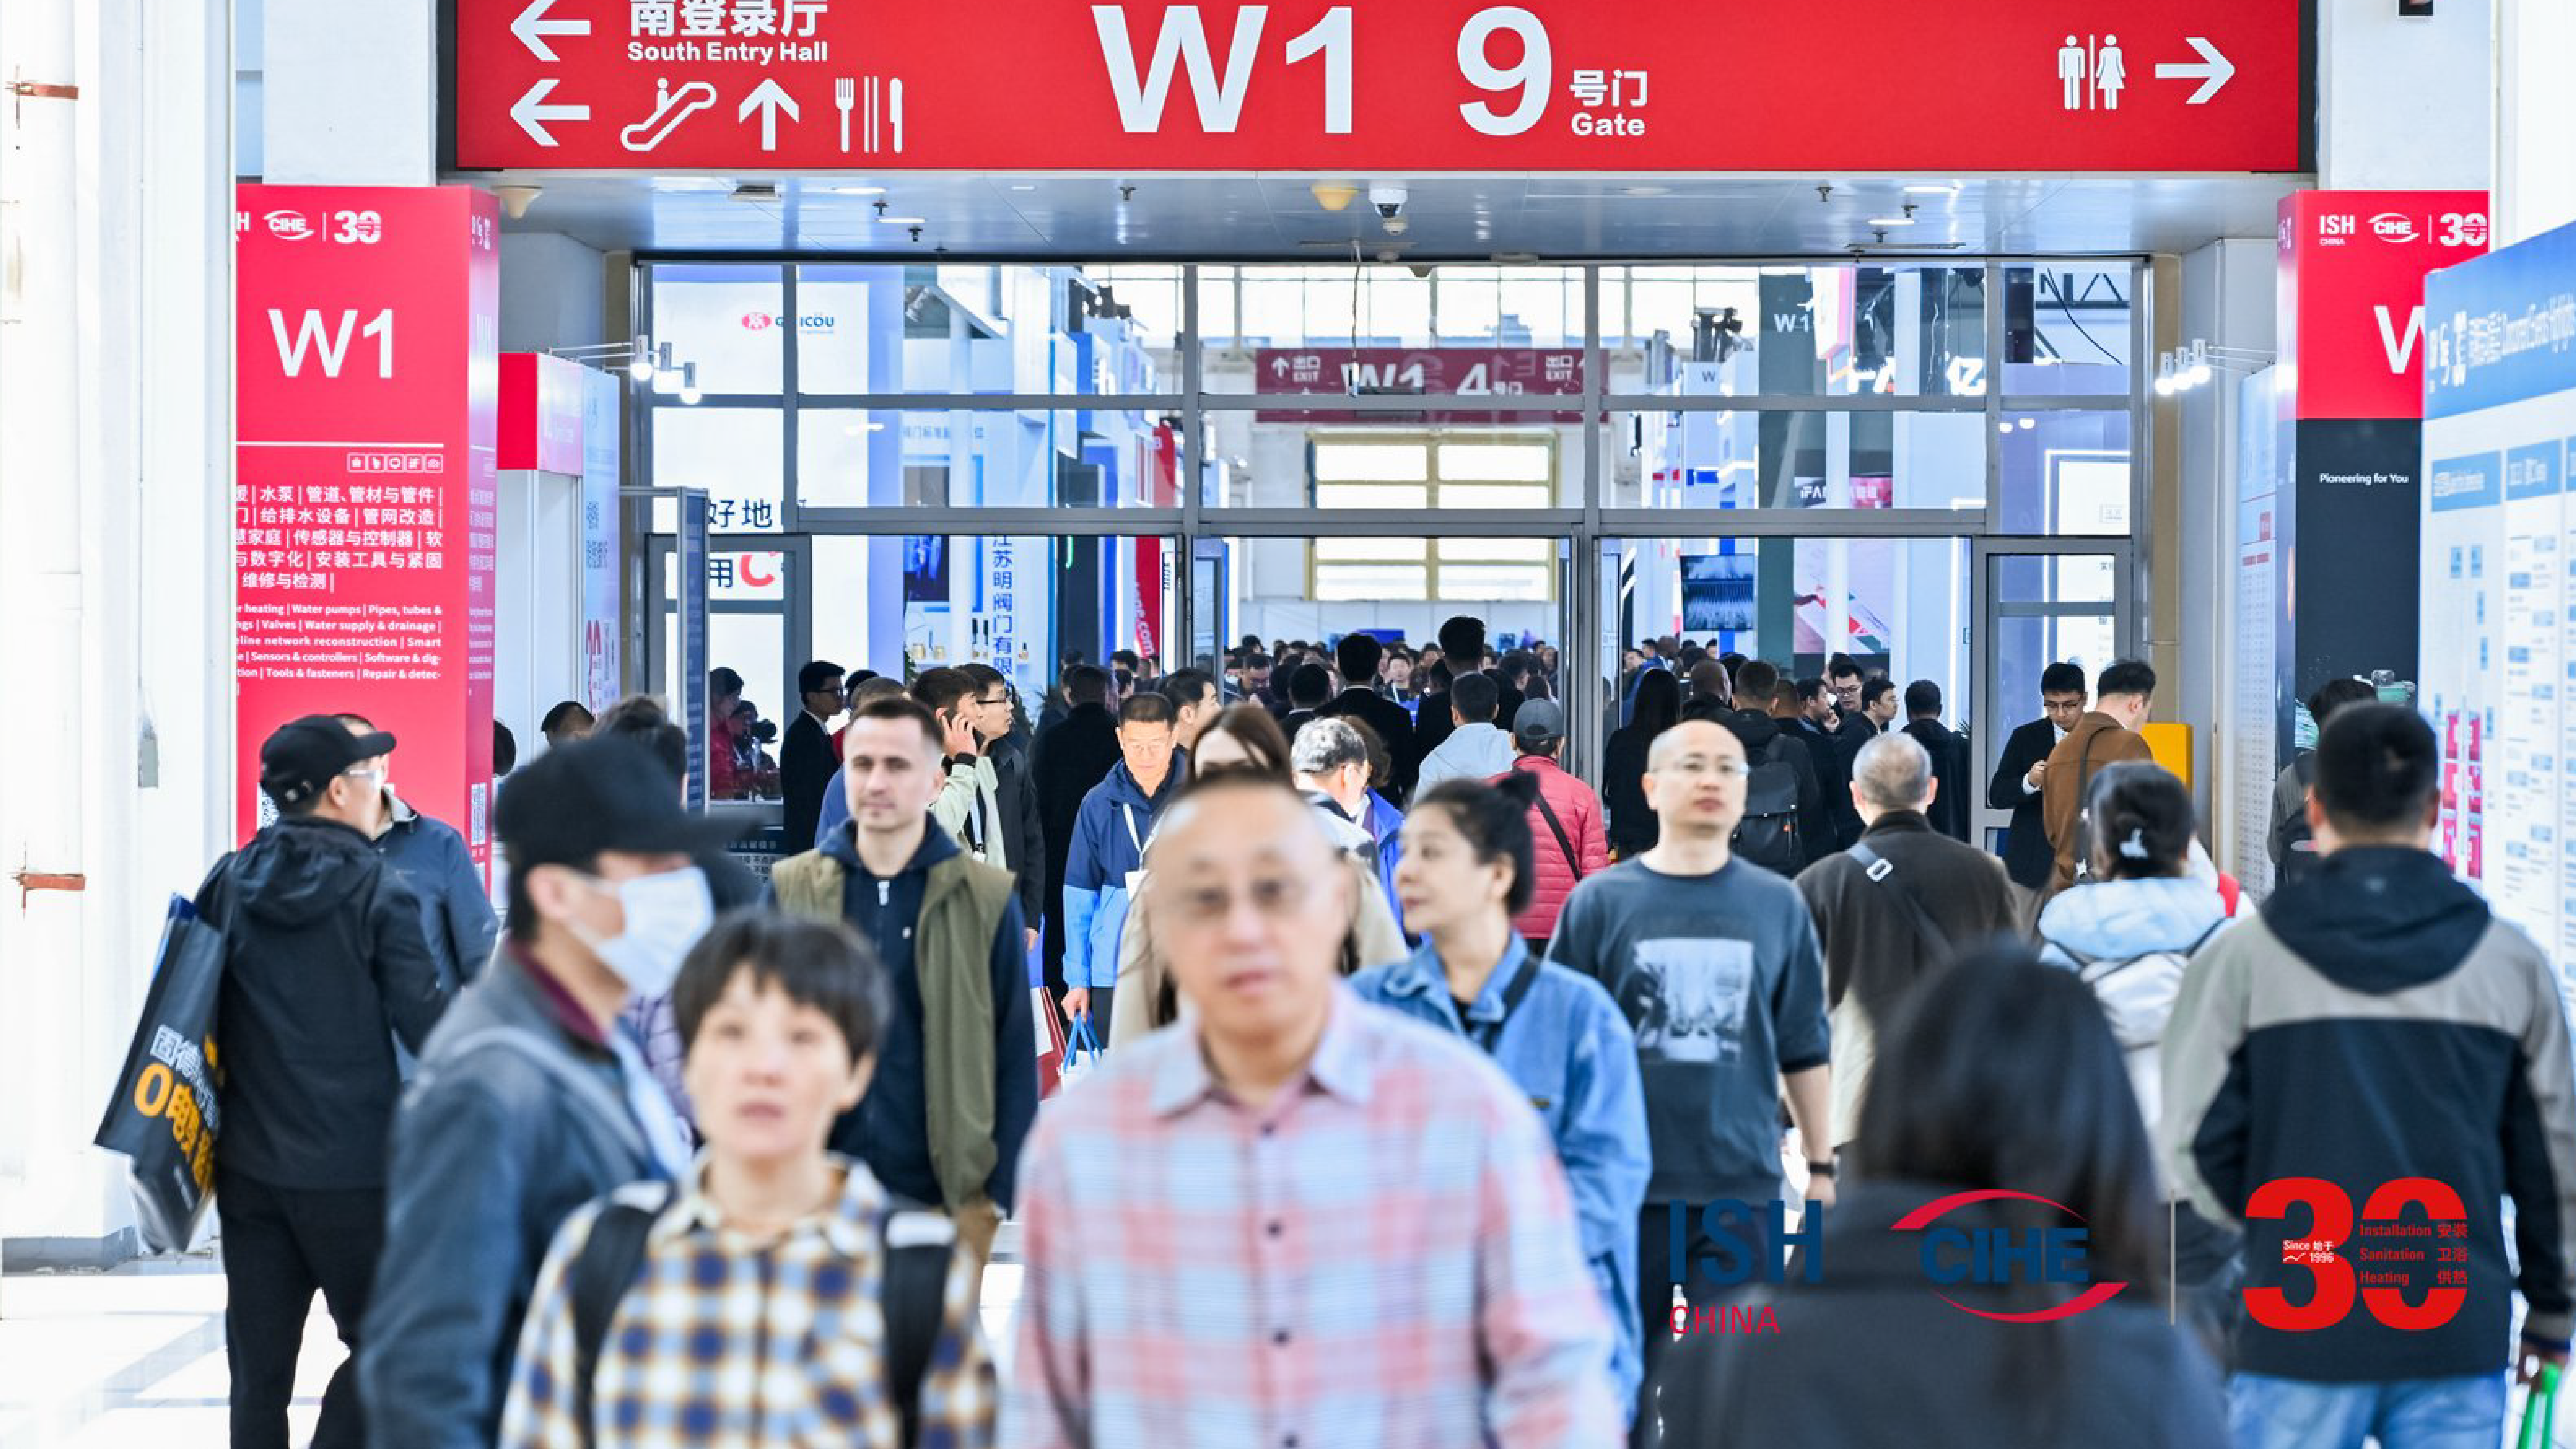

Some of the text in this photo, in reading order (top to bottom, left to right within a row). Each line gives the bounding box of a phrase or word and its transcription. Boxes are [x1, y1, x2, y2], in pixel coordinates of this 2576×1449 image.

[630, 0, 827, 37] 南登录厅
[628, 41, 827, 65] South Entry Hall
[1092, 5, 1551, 135] W1 9
[1569, 70, 1647, 106] 号门
[1572, 112, 1644, 135] Gate
[268, 217, 308, 232] CIHE
[2320, 215, 2355, 234] ISH
[2372, 220, 2413, 234] CIHE
[1773, 313, 1811, 333] W1
[268, 309, 393, 378] W1
[2319, 473, 2409, 486] Pioneering for You
[244, 604, 284, 616] heating
[292, 604, 323, 613] Water
[325, 607, 361, 616] pumps
[403, 605, 432, 615] tubes
[262, 620, 296, 629] Valves
[304, 620, 337, 629] Water
[339, 621, 375, 633] supply
[388, 621, 436, 633] drainage
[264, 636, 311, 646] network
[314, 636, 397, 646] reconstruction
[407, 638, 441, 647] Smart
[251, 652, 291, 662] Sensors
[303, 652, 358, 662] controllers
[365, 652, 410, 663] Software
[267, 667, 294, 678] Tools
[306, 668, 355, 679] fasteners
[363, 669, 397, 680] Repair
